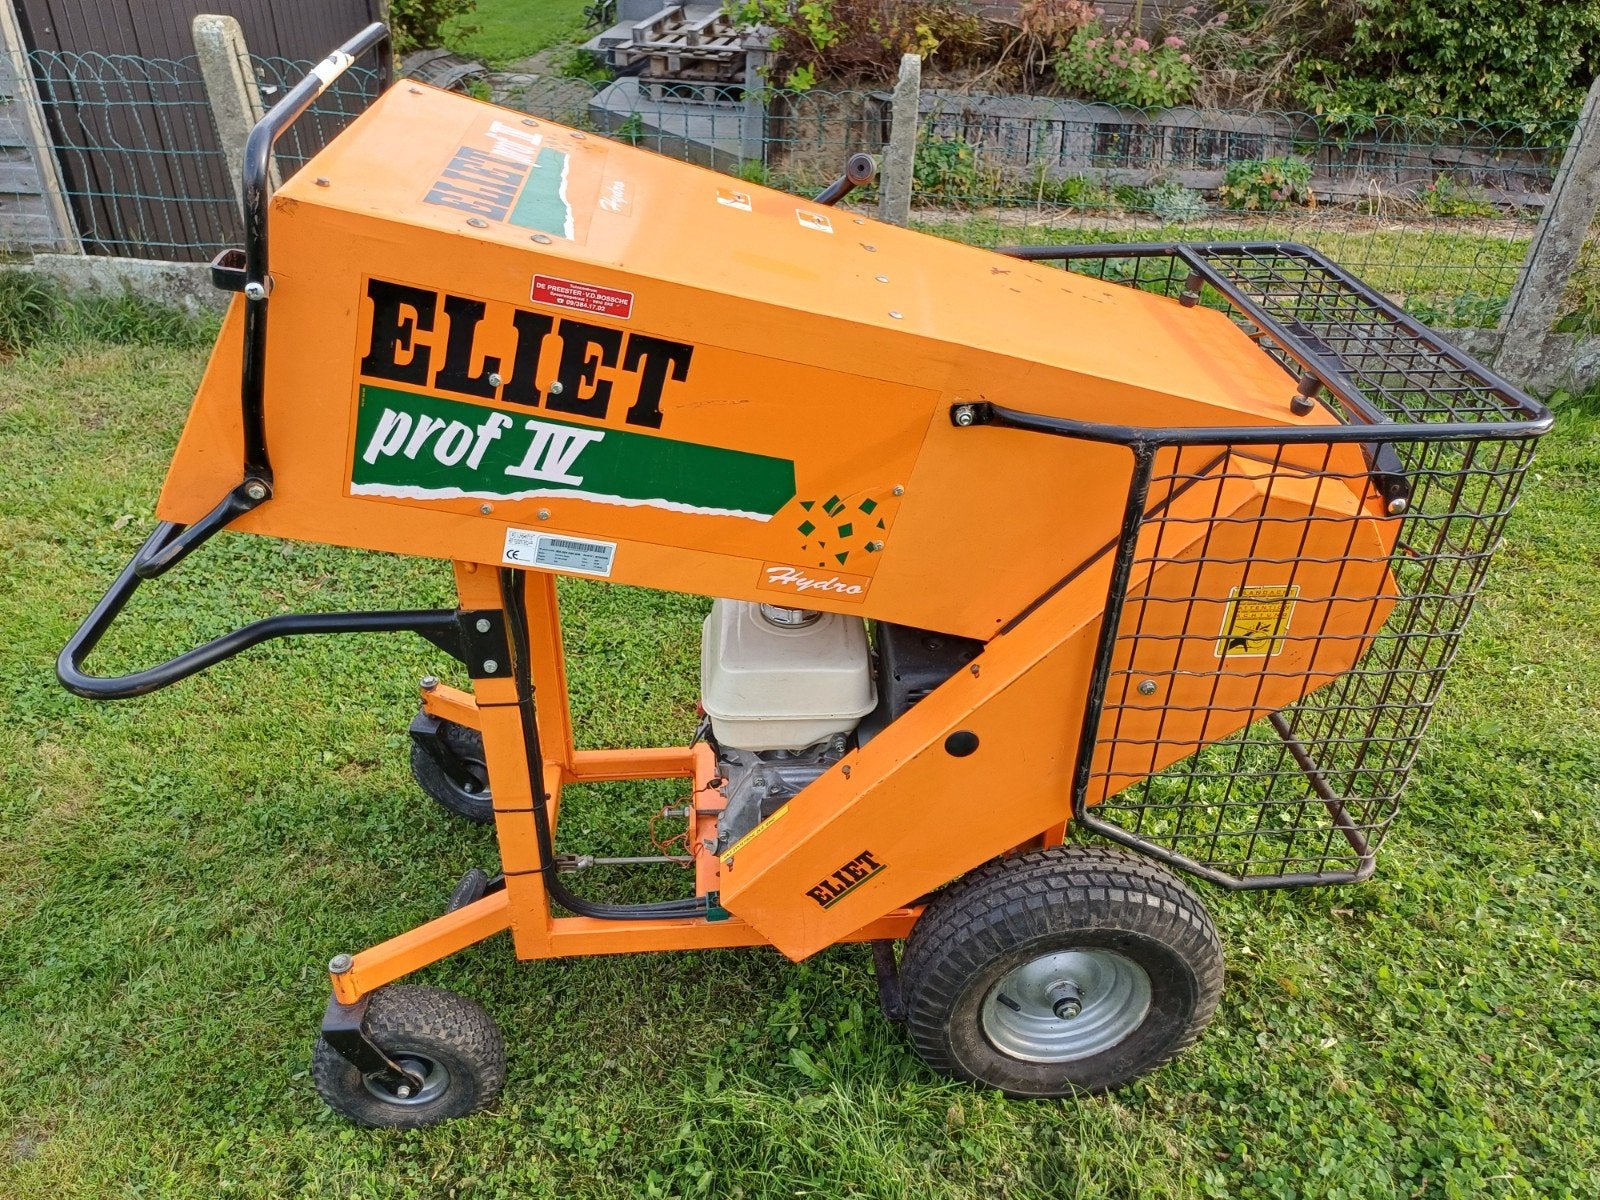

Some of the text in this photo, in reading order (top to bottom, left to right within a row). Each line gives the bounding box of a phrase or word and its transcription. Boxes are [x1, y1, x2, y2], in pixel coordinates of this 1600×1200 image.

[423, 146, 530, 222] ELIET
[536, 282, 546, 290] DE
[547, 284, 582, 297] PREESTER
[360, 277, 695, 430] ELIET
[362, 408, 606, 487] prof IV
[766, 566, 864, 595] Hydro
[805, 849, 882, 907] ELIET
